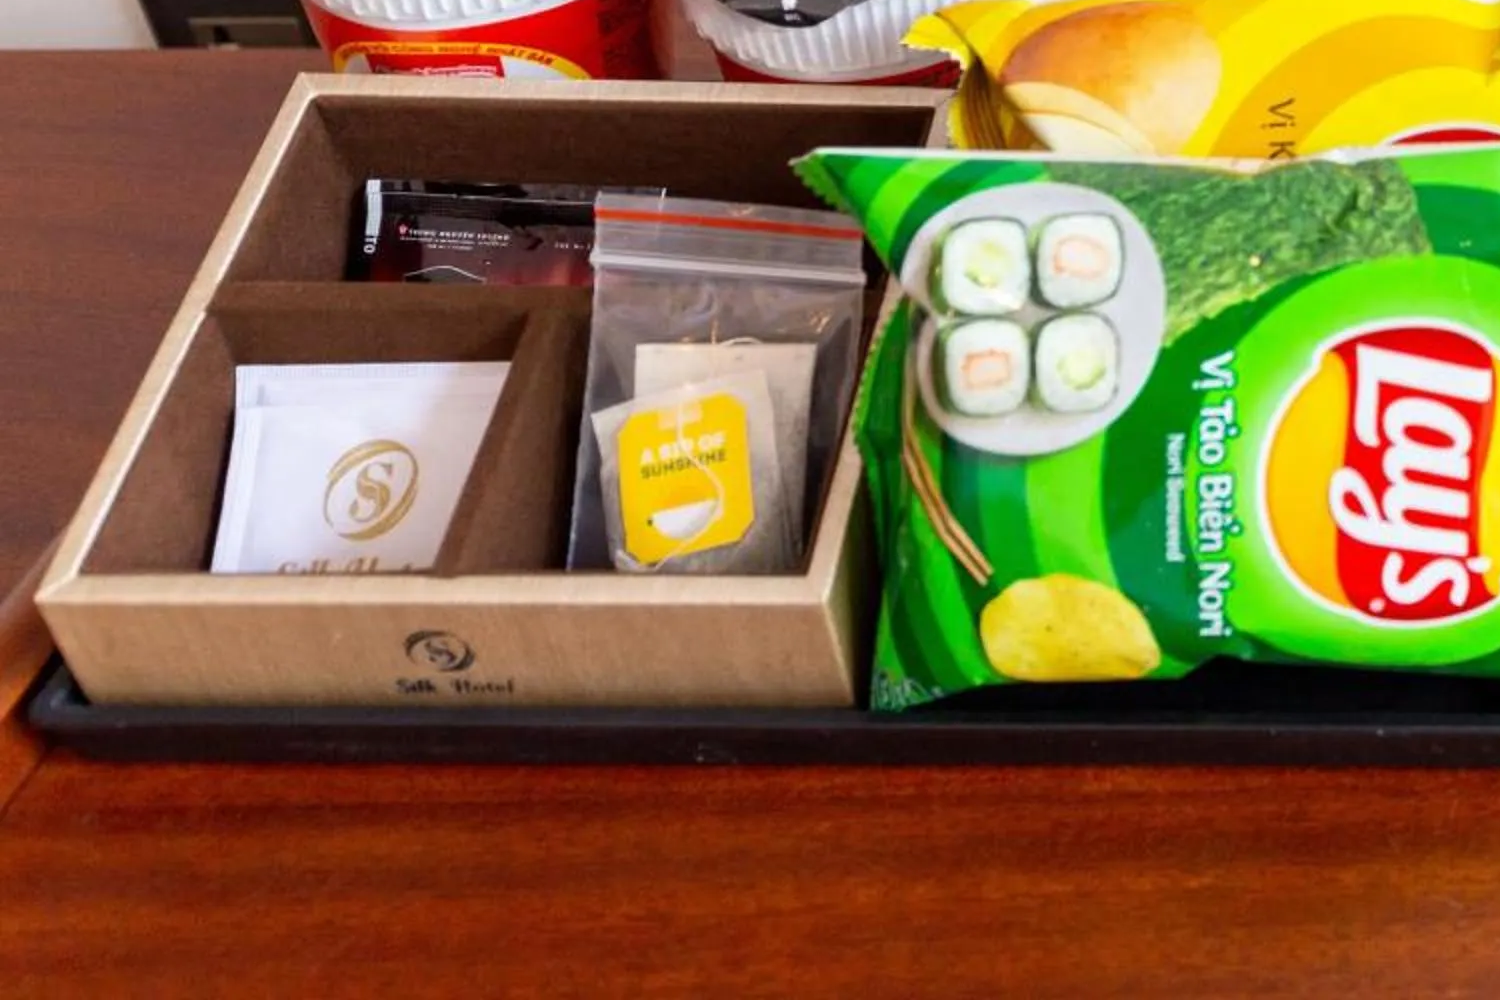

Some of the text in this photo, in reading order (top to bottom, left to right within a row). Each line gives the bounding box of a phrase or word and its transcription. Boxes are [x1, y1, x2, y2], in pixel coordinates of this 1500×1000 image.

[1268, 141, 1297, 159] K
[1192, 350, 1235, 391] Vị
[1166, 432, 1186, 475] Nori
[348, 462, 394, 523] S
[1329, 343, 1494, 613] Lay's
[1198, 561, 1234, 638] Nori
[451, 678, 514, 695] Hotel
